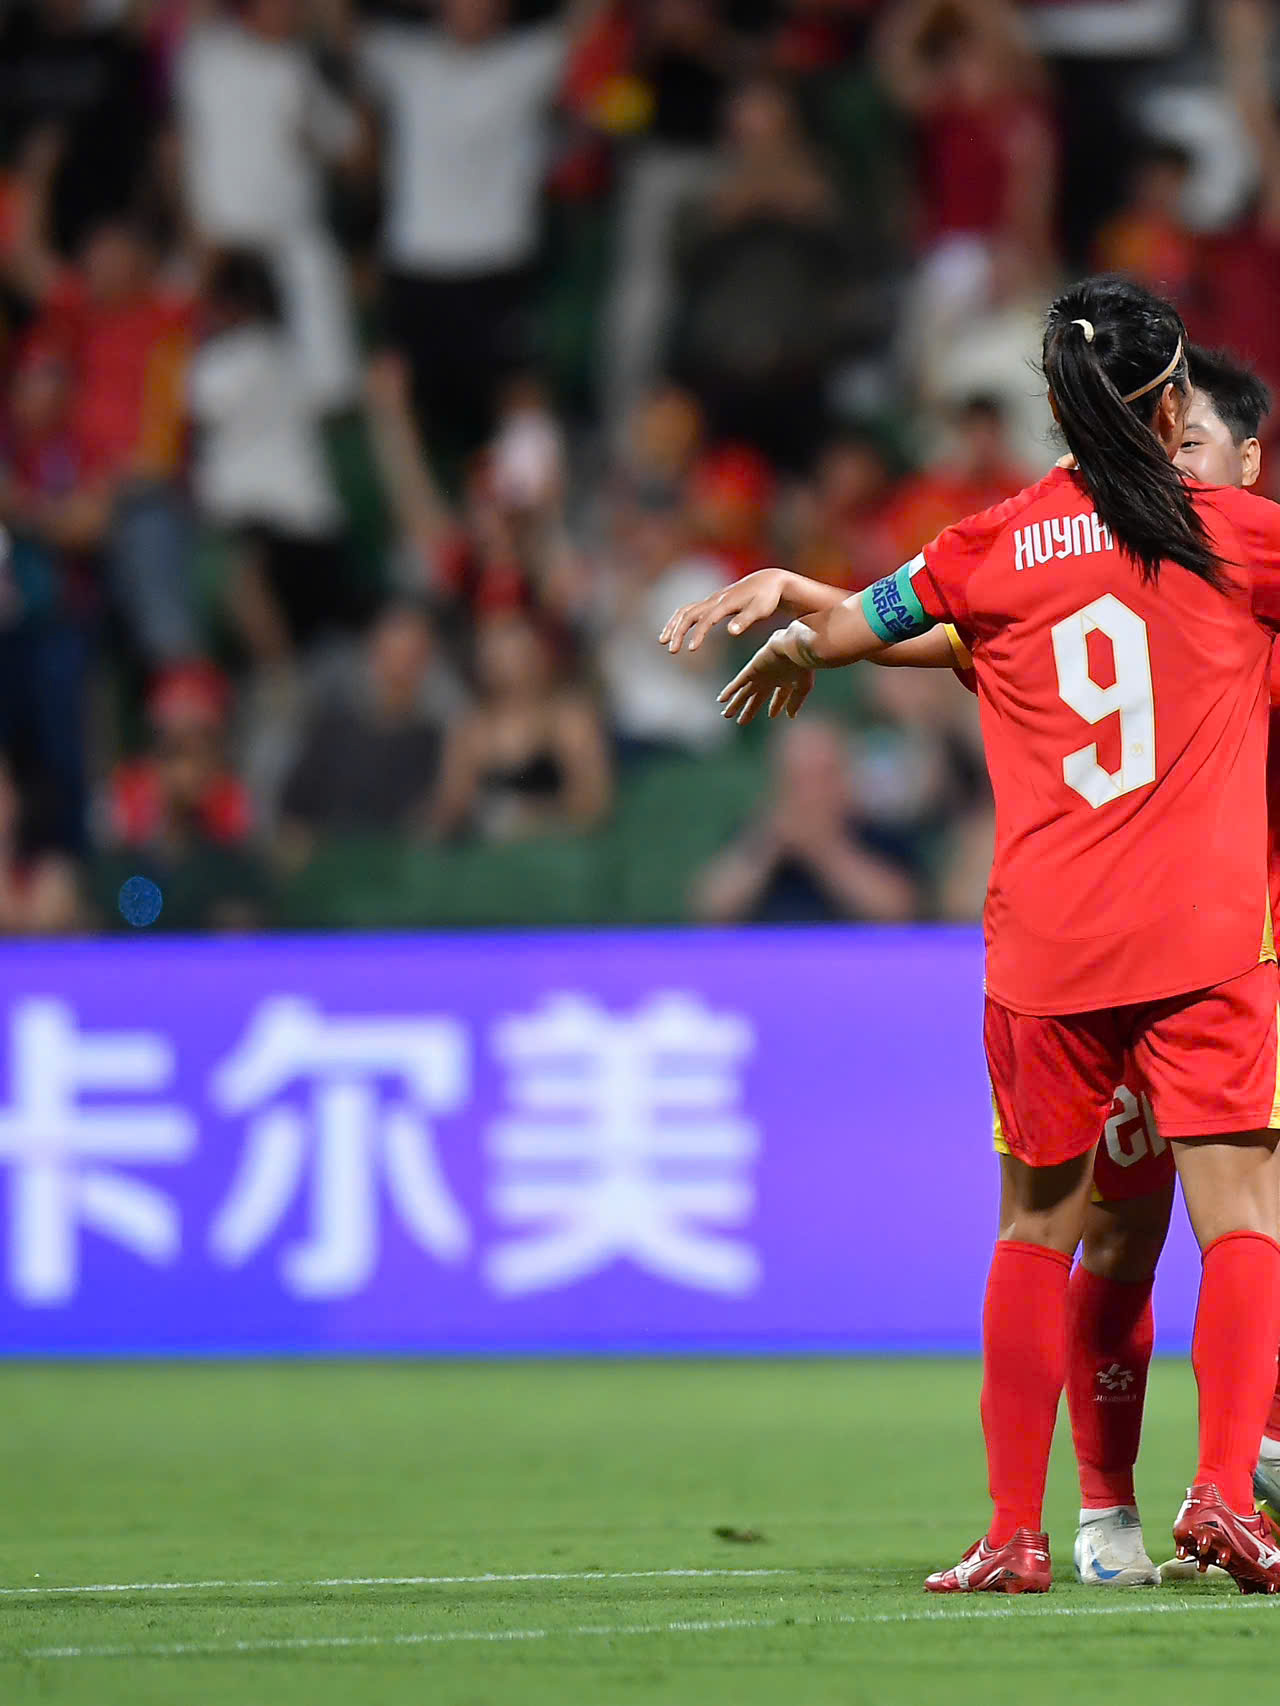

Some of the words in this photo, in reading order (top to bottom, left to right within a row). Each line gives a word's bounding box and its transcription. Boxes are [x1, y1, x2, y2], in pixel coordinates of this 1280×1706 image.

[1050, 592, 1156, 809] 9
[0, 993, 762, 1302] 卡尔美
